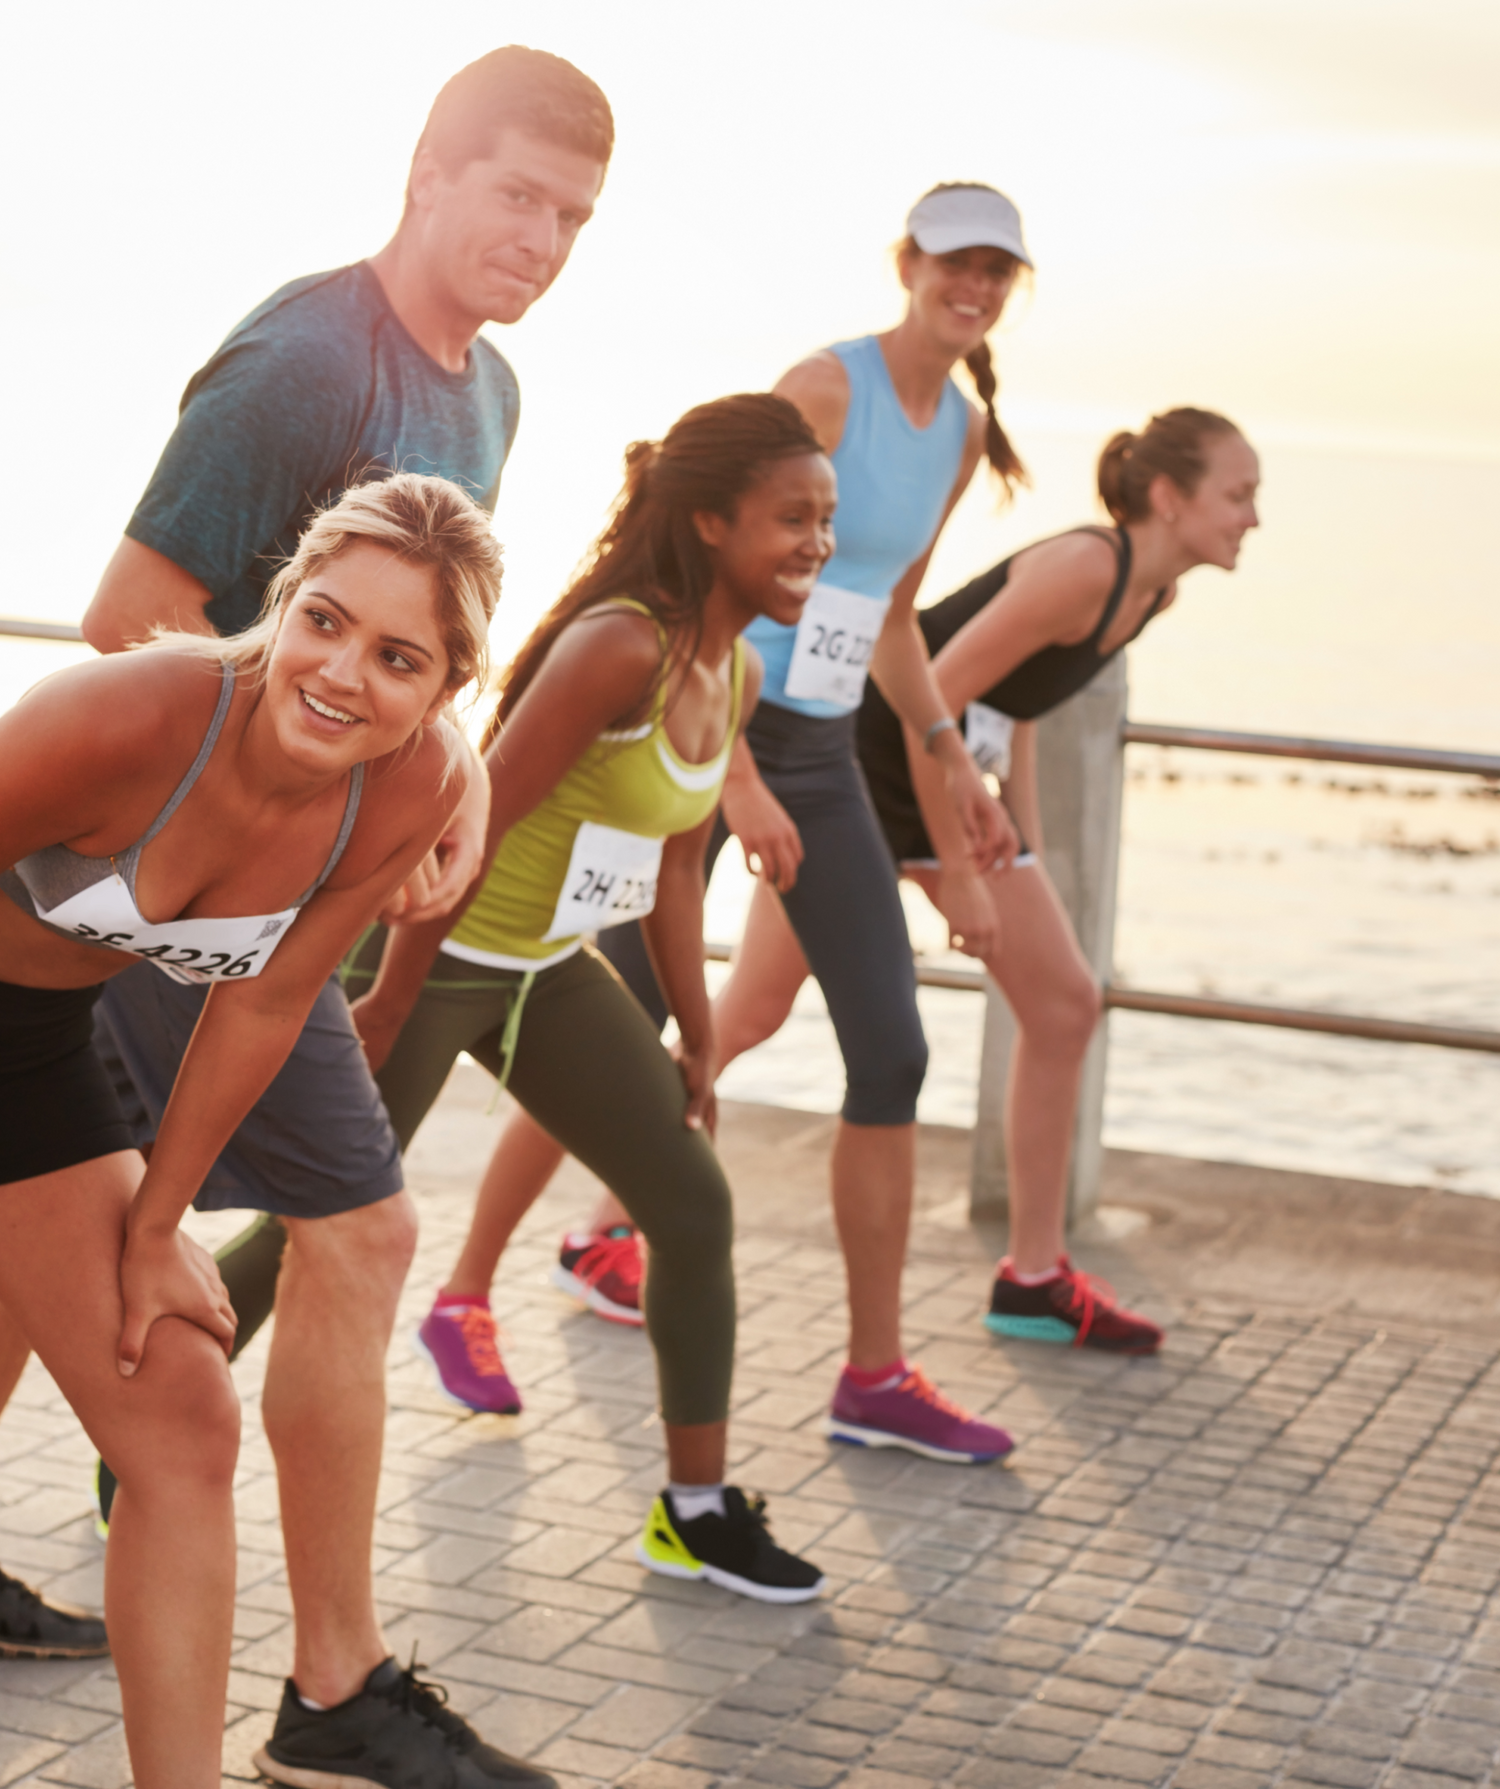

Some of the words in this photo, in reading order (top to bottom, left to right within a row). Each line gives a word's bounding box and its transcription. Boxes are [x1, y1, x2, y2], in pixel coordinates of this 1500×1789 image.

[809, 624, 846, 661] 2G
[573, 869, 616, 907] 2H
[133, 944, 261, 977] 4226
